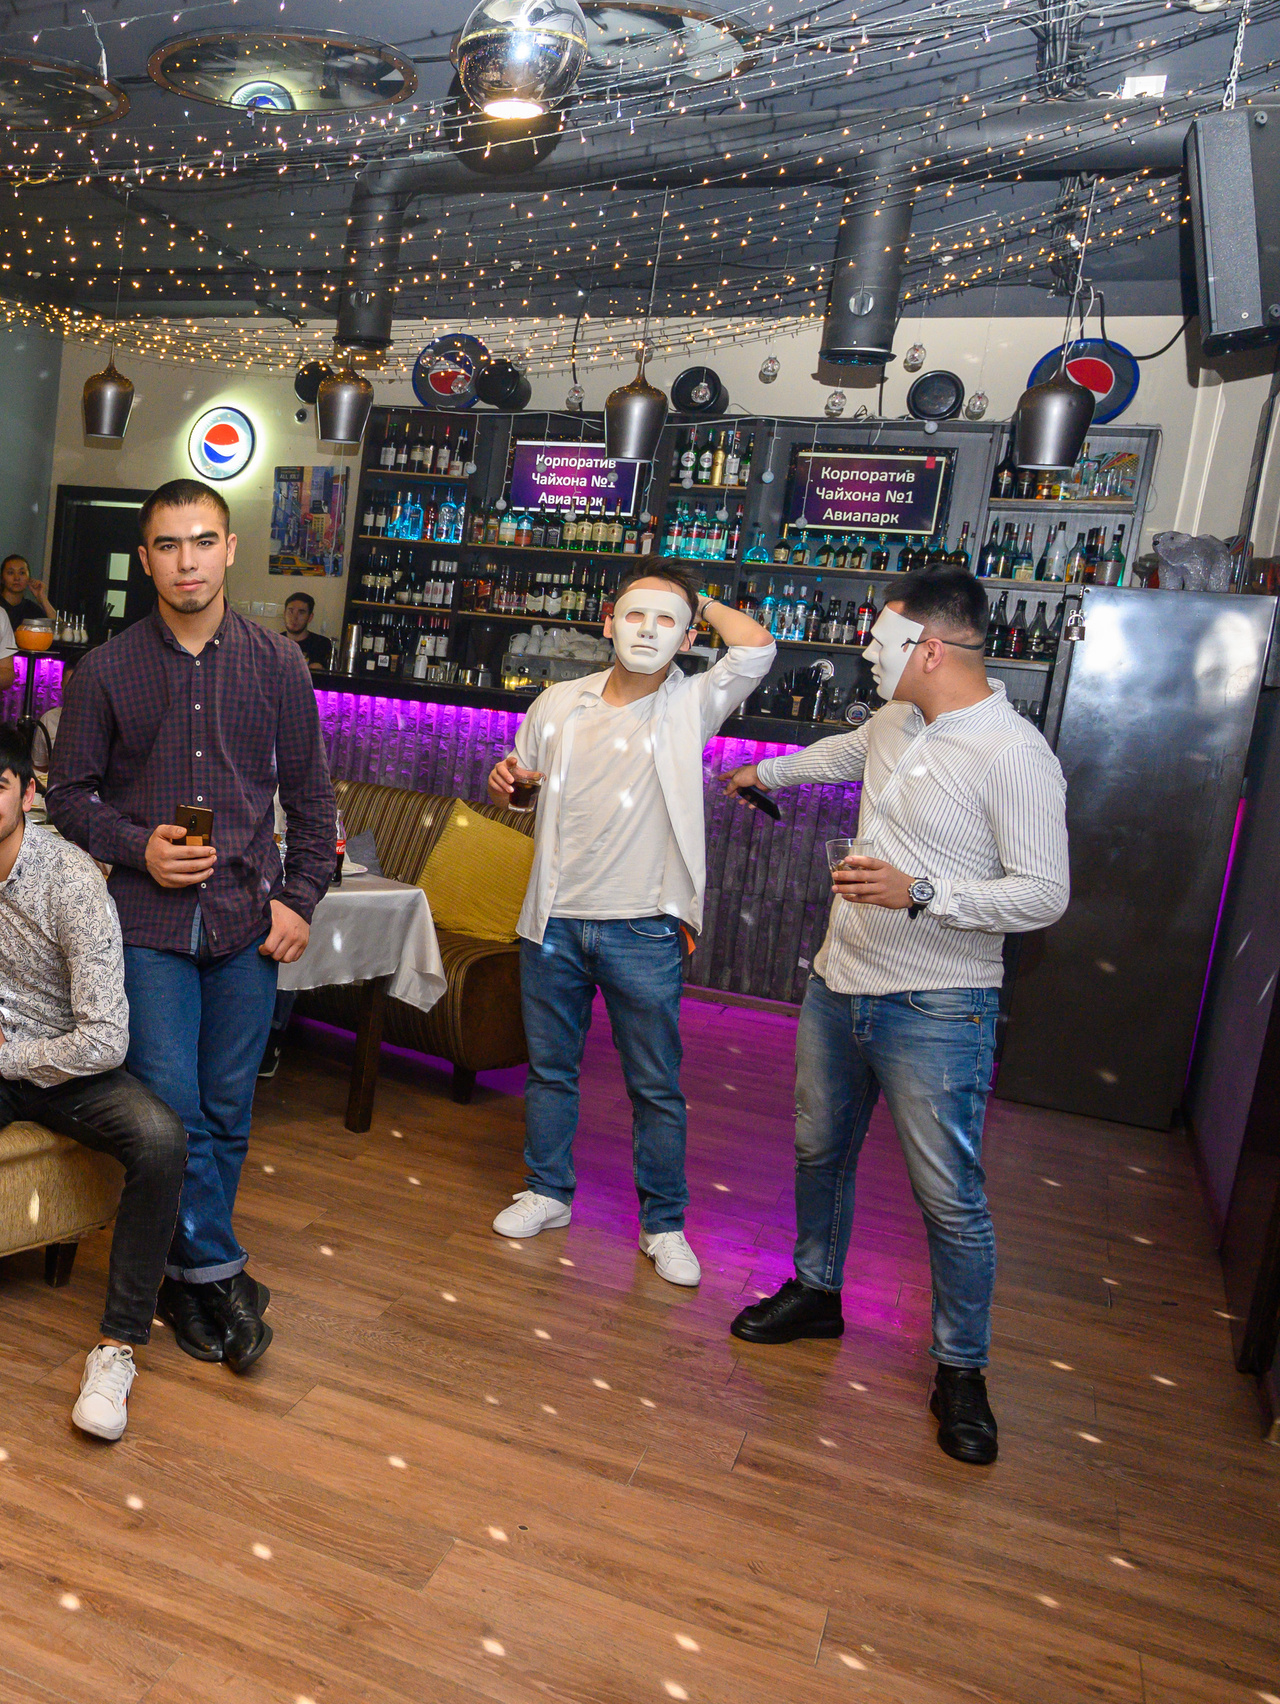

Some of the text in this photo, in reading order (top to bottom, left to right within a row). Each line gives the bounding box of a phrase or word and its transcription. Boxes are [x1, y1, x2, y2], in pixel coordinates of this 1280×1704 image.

[531, 472, 587, 487] Чайхона
[821, 466, 916, 483] Корпоратив
[816, 487, 914, 504] Чайхона №1
[822, 507, 900, 526] Авиапарк
